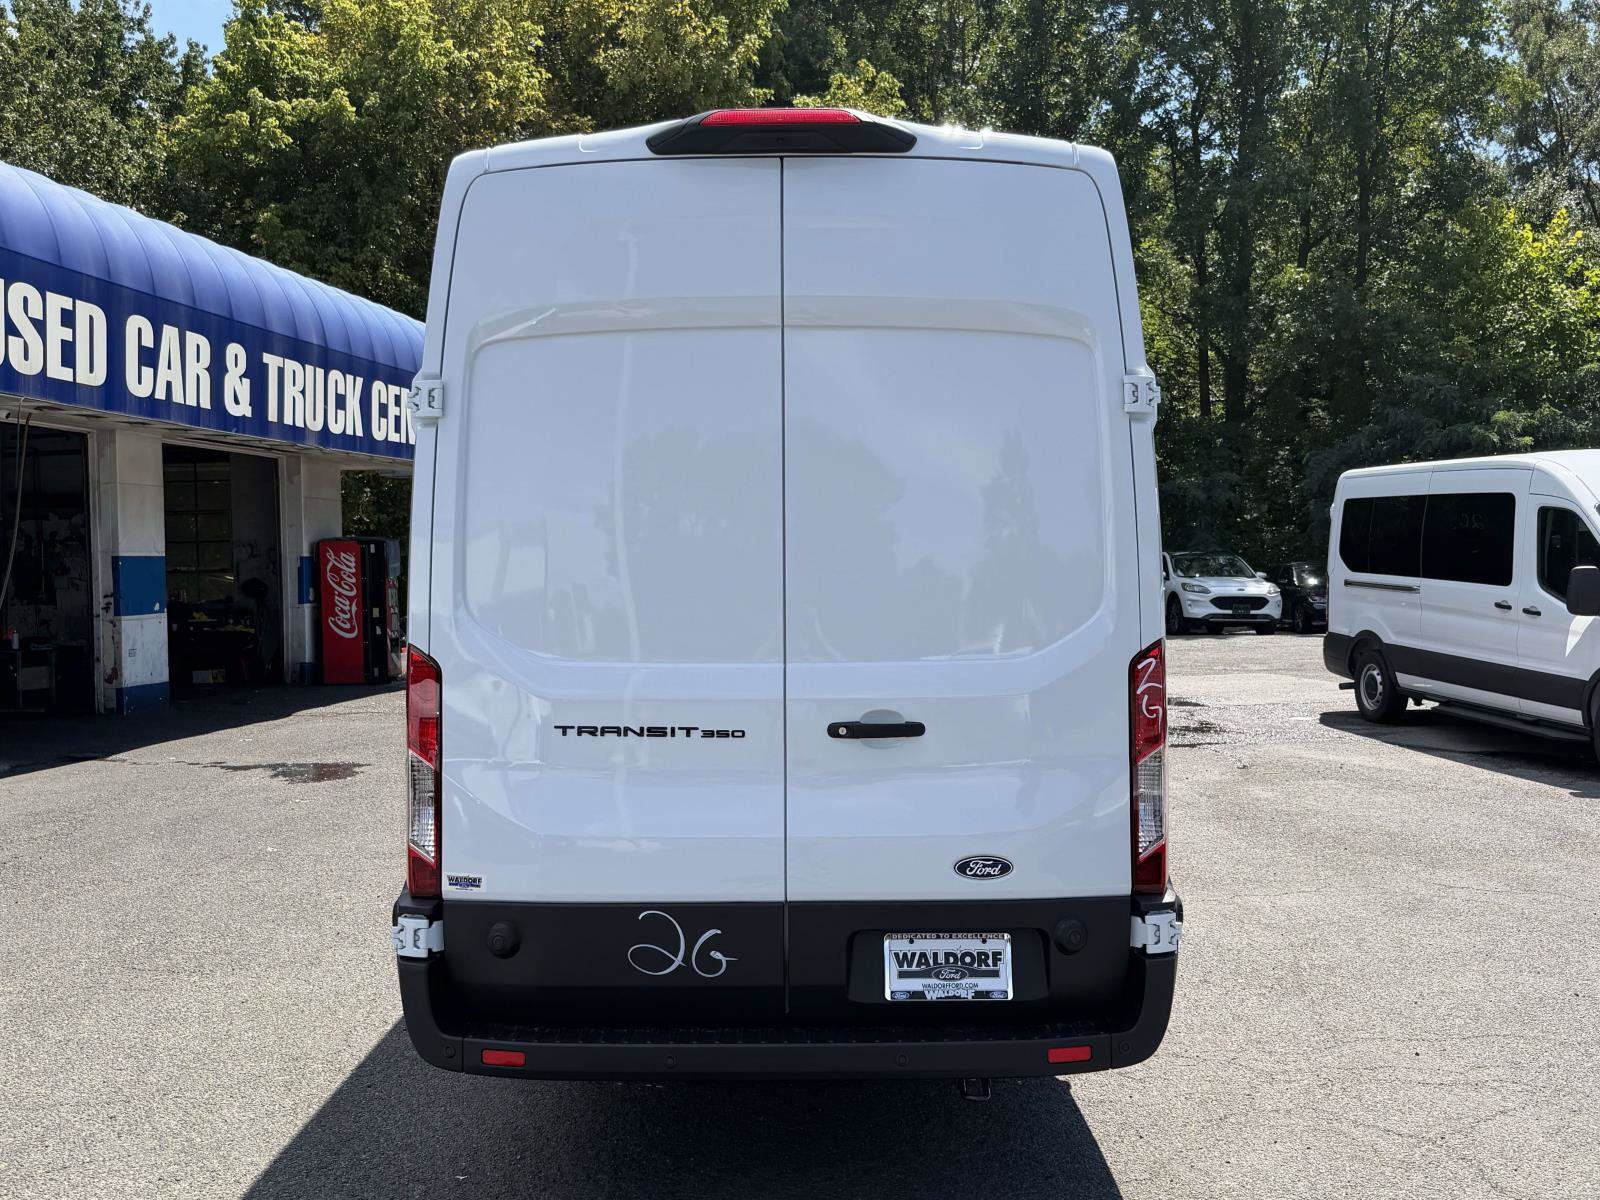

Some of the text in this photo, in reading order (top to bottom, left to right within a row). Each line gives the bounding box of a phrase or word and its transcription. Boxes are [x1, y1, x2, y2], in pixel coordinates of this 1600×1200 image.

[0, 278, 107, 387] SED
[125, 314, 211, 410] CAR
[224, 342, 252, 418] &
[262, 352, 363, 438] TRUCK
[966, 859, 1002, 876] Ford
[893, 951, 1003, 968] WALDORF
[939, 968, 962, 980] Ford
[924, 989, 975, 1000] WALDORF
